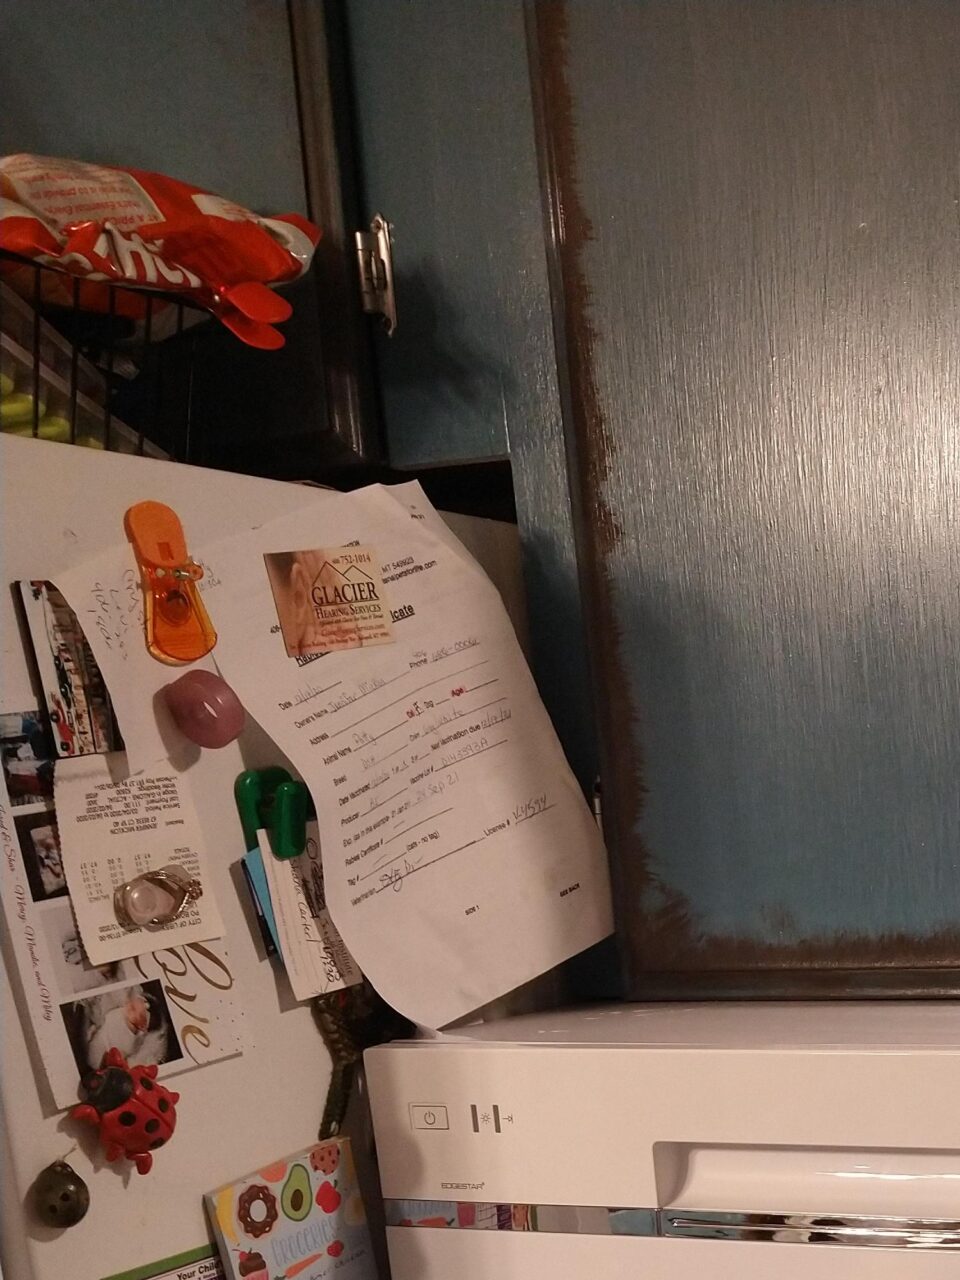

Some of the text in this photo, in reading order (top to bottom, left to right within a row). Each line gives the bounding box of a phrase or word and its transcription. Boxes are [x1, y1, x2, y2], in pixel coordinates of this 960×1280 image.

[311, 581, 379, 606] GLACIER
[316, 603, 381, 619] HEARING SERVICES
[409, 658, 428, 669] Phone
[451, 687, 466, 697] Age
[483, 821, 506, 837] License
[441, 1182, 483, 1190] EDGESTAR
[271, 1217, 337, 1268] GROCERIES
